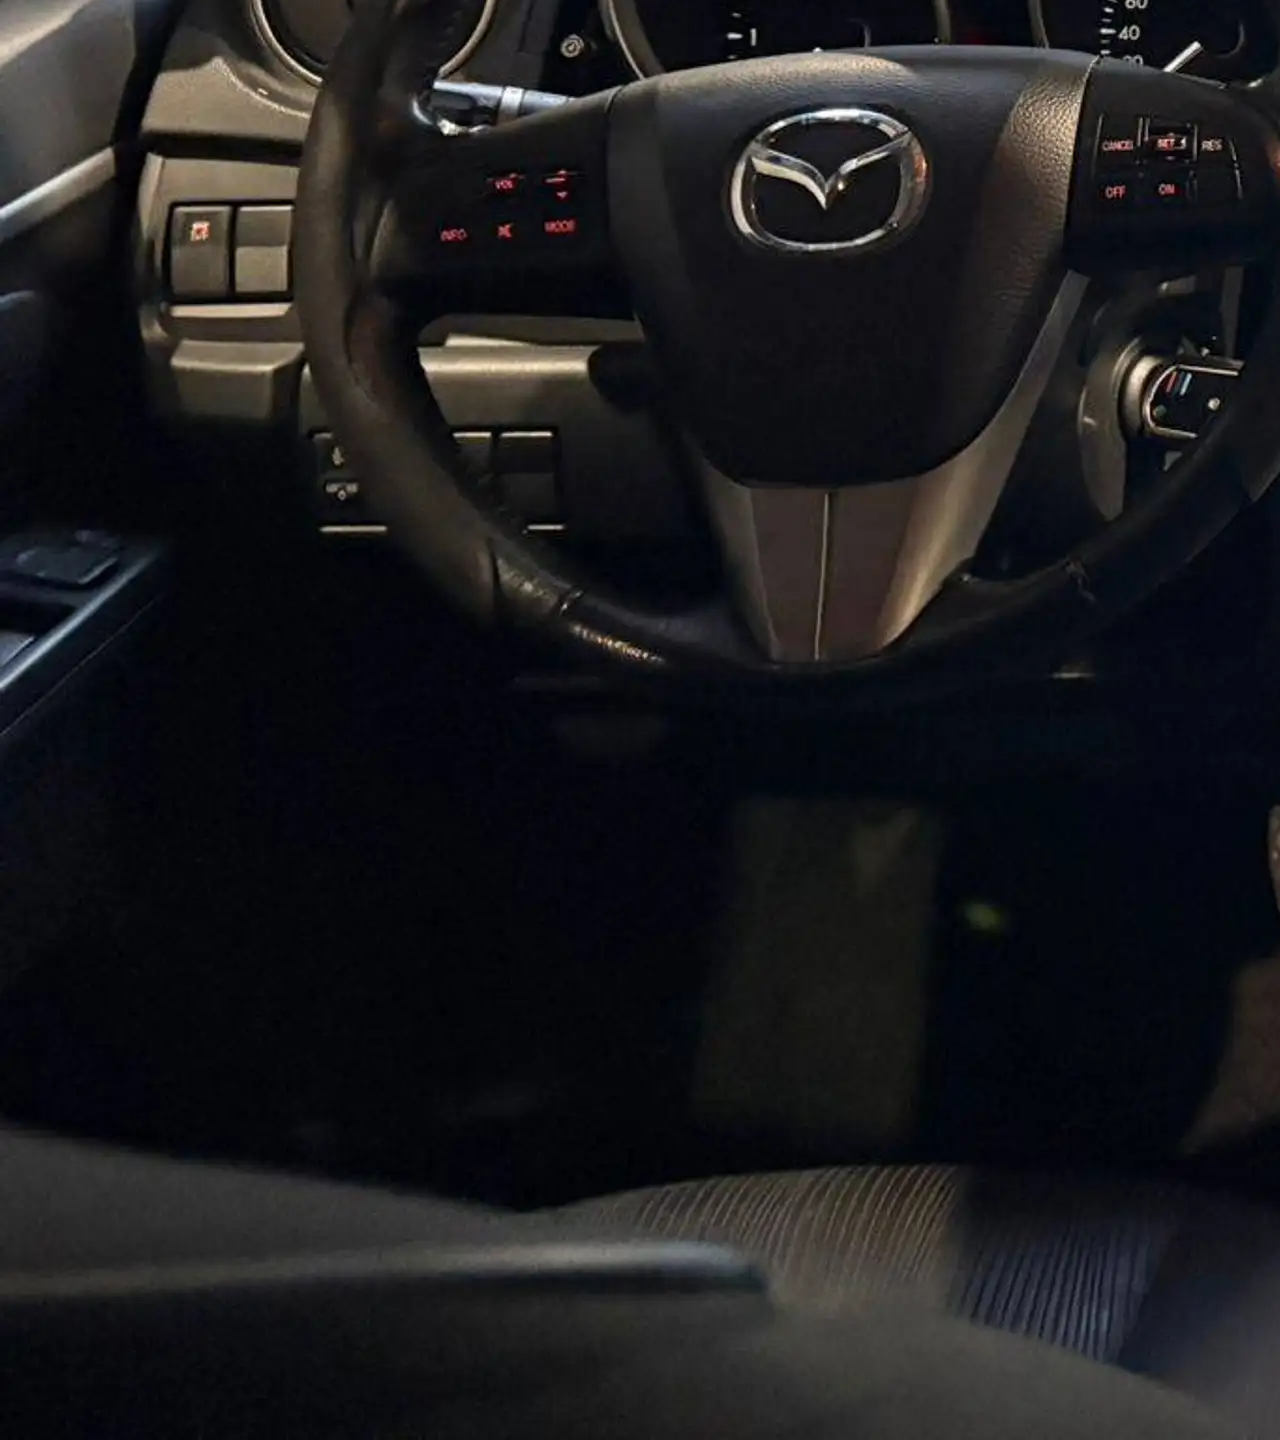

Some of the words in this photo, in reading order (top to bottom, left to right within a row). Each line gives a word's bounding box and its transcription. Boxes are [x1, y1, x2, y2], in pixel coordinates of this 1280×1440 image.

[750, 28, 757, 46] 1
[1118, 24, 1141, 40] 40
[1102, 140, 1134, 152] CANCEL
[1105, 185, 1127, 199] OFF
[1158, 184, 1175, 195] ON
